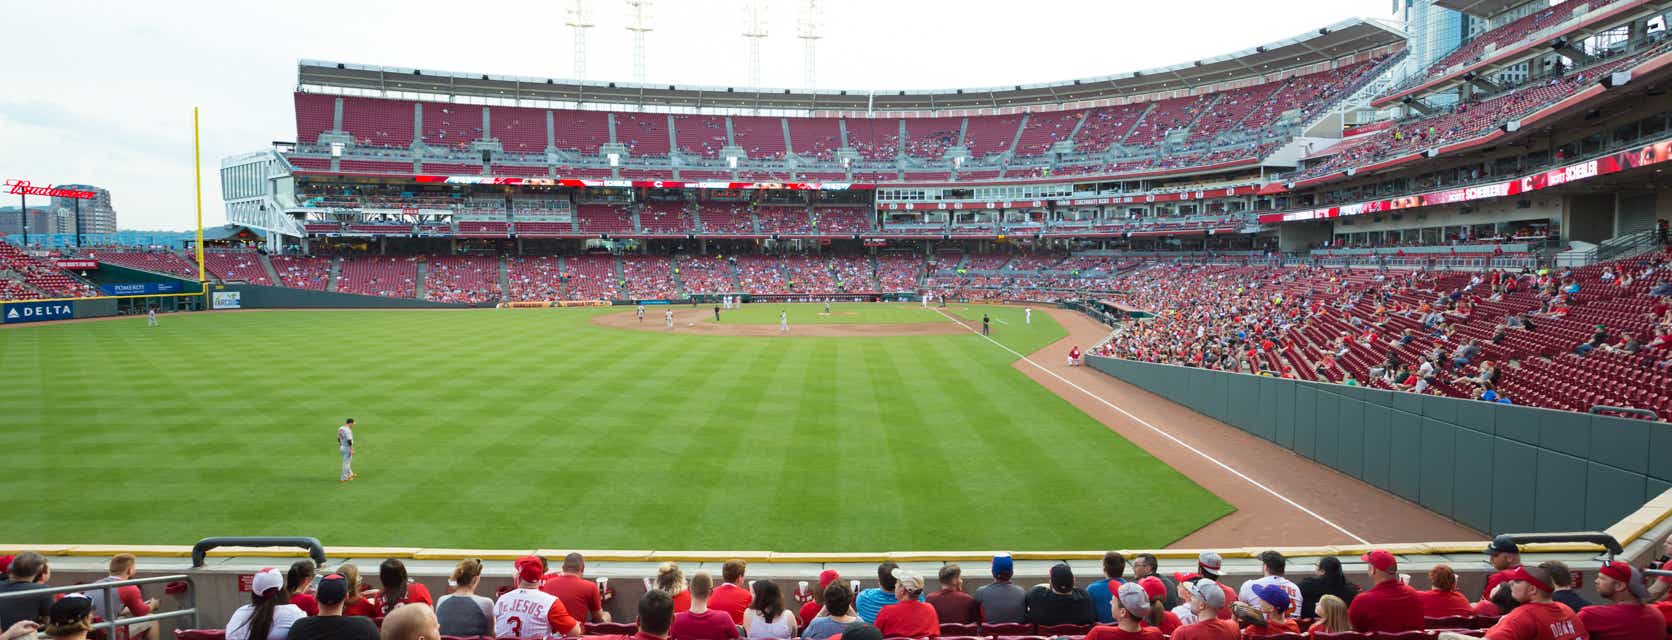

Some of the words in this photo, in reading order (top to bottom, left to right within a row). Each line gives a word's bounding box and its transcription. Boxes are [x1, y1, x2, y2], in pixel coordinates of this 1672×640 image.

[1566, 160, 1598, 182] SCHEBLER
[1465, 183, 1501, 201] SCHEBLER
[24, 305, 71, 317] DELTA
[510, 599, 543, 616] JESUS
